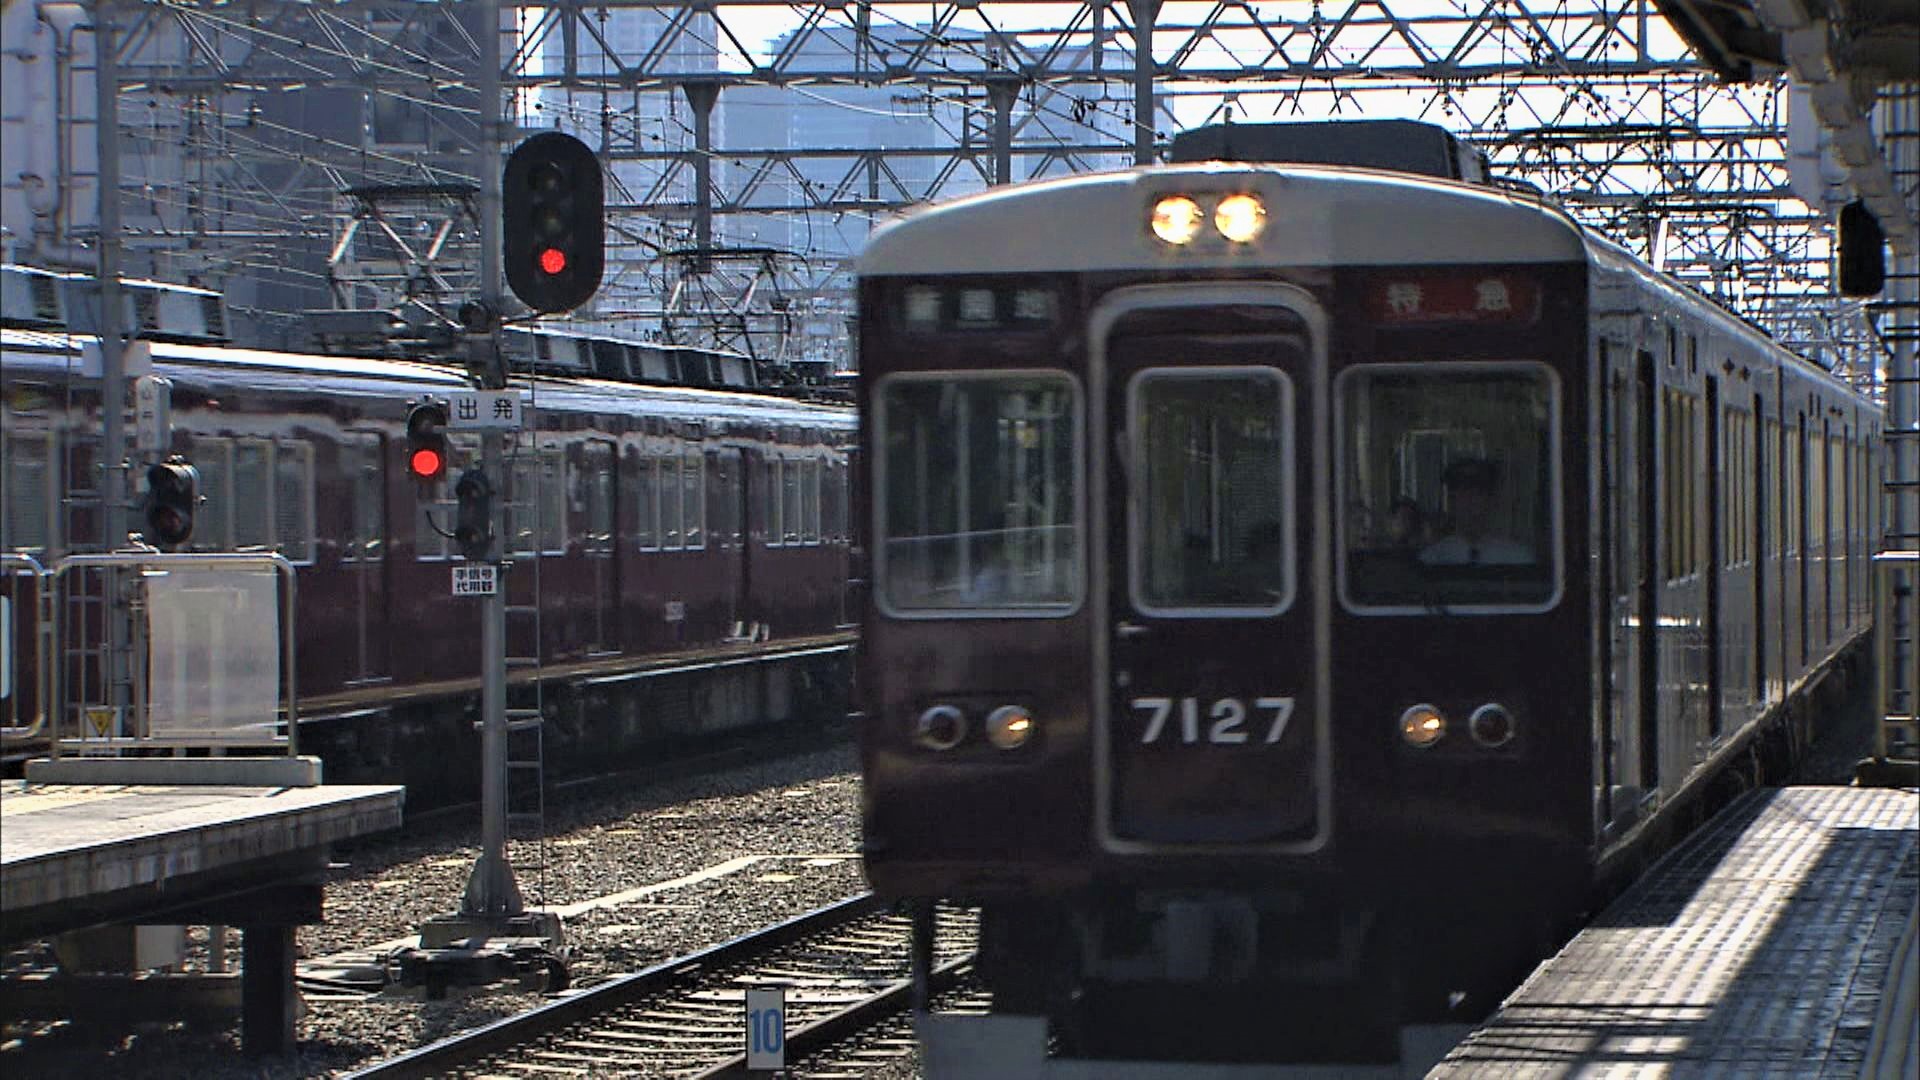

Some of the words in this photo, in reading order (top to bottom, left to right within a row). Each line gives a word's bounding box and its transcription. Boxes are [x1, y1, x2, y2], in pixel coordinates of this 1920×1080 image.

[458, 398, 513, 420] 出発
[1133, 697, 1296, 744] 7127
[750, 1008, 782, 1054] 10
